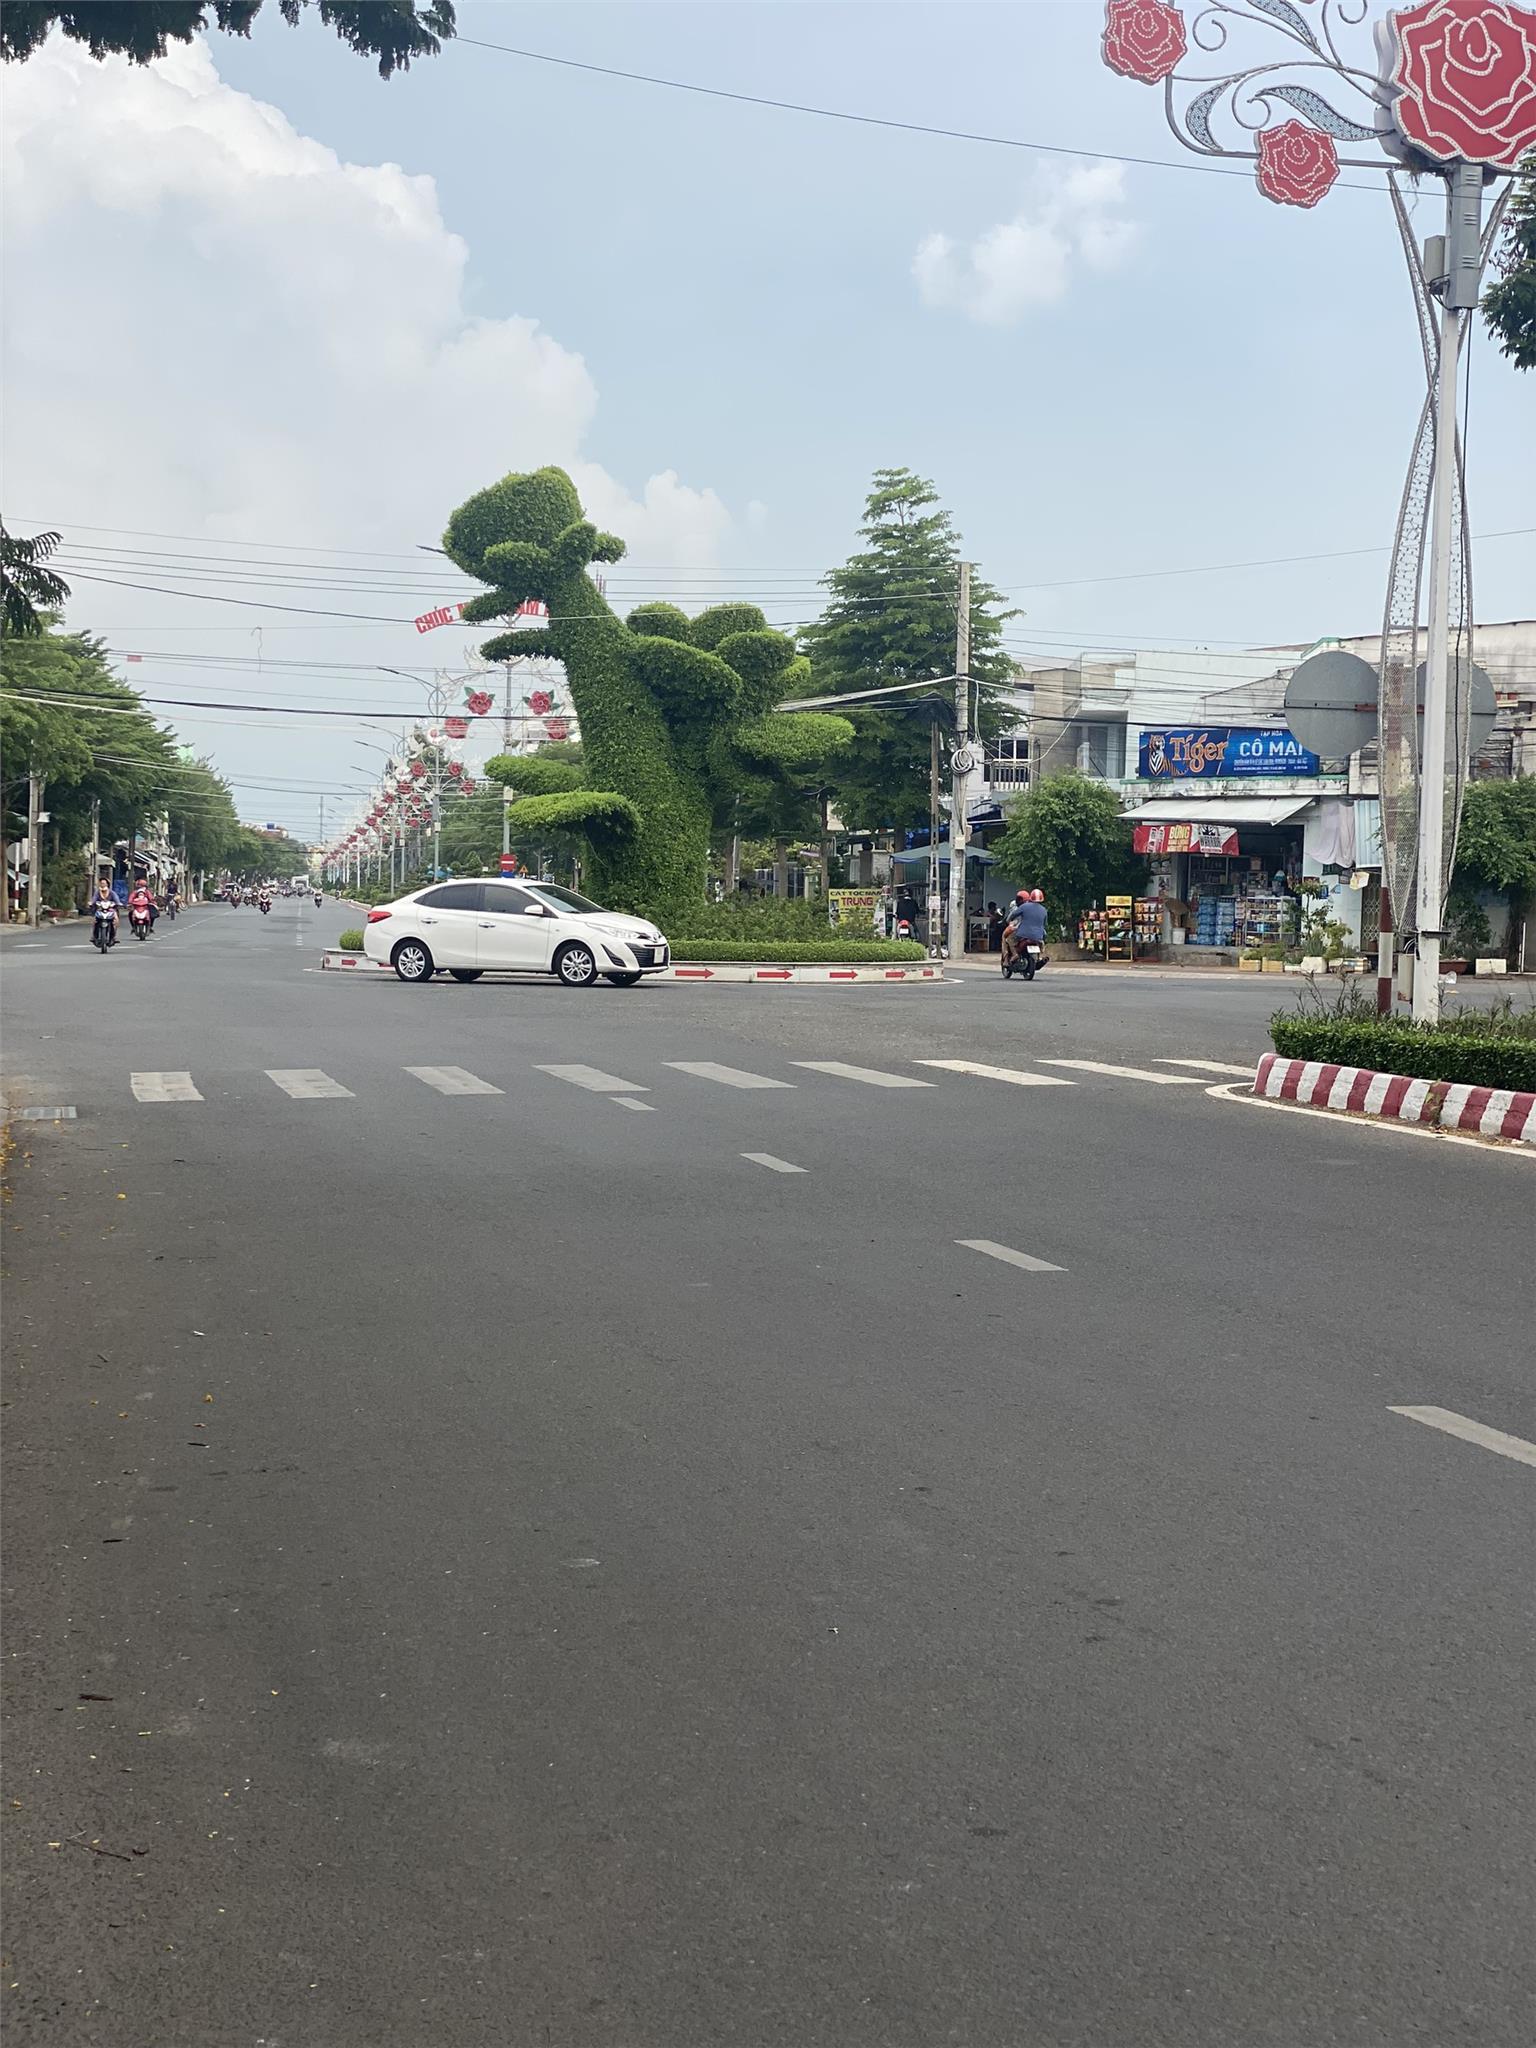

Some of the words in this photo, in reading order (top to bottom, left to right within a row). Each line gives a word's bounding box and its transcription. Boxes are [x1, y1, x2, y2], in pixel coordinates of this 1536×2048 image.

[1169, 733, 1229, 773] Tiger
[1239, 738, 1263, 757] CÔ
[1269, 740, 1303, 756] MAI
